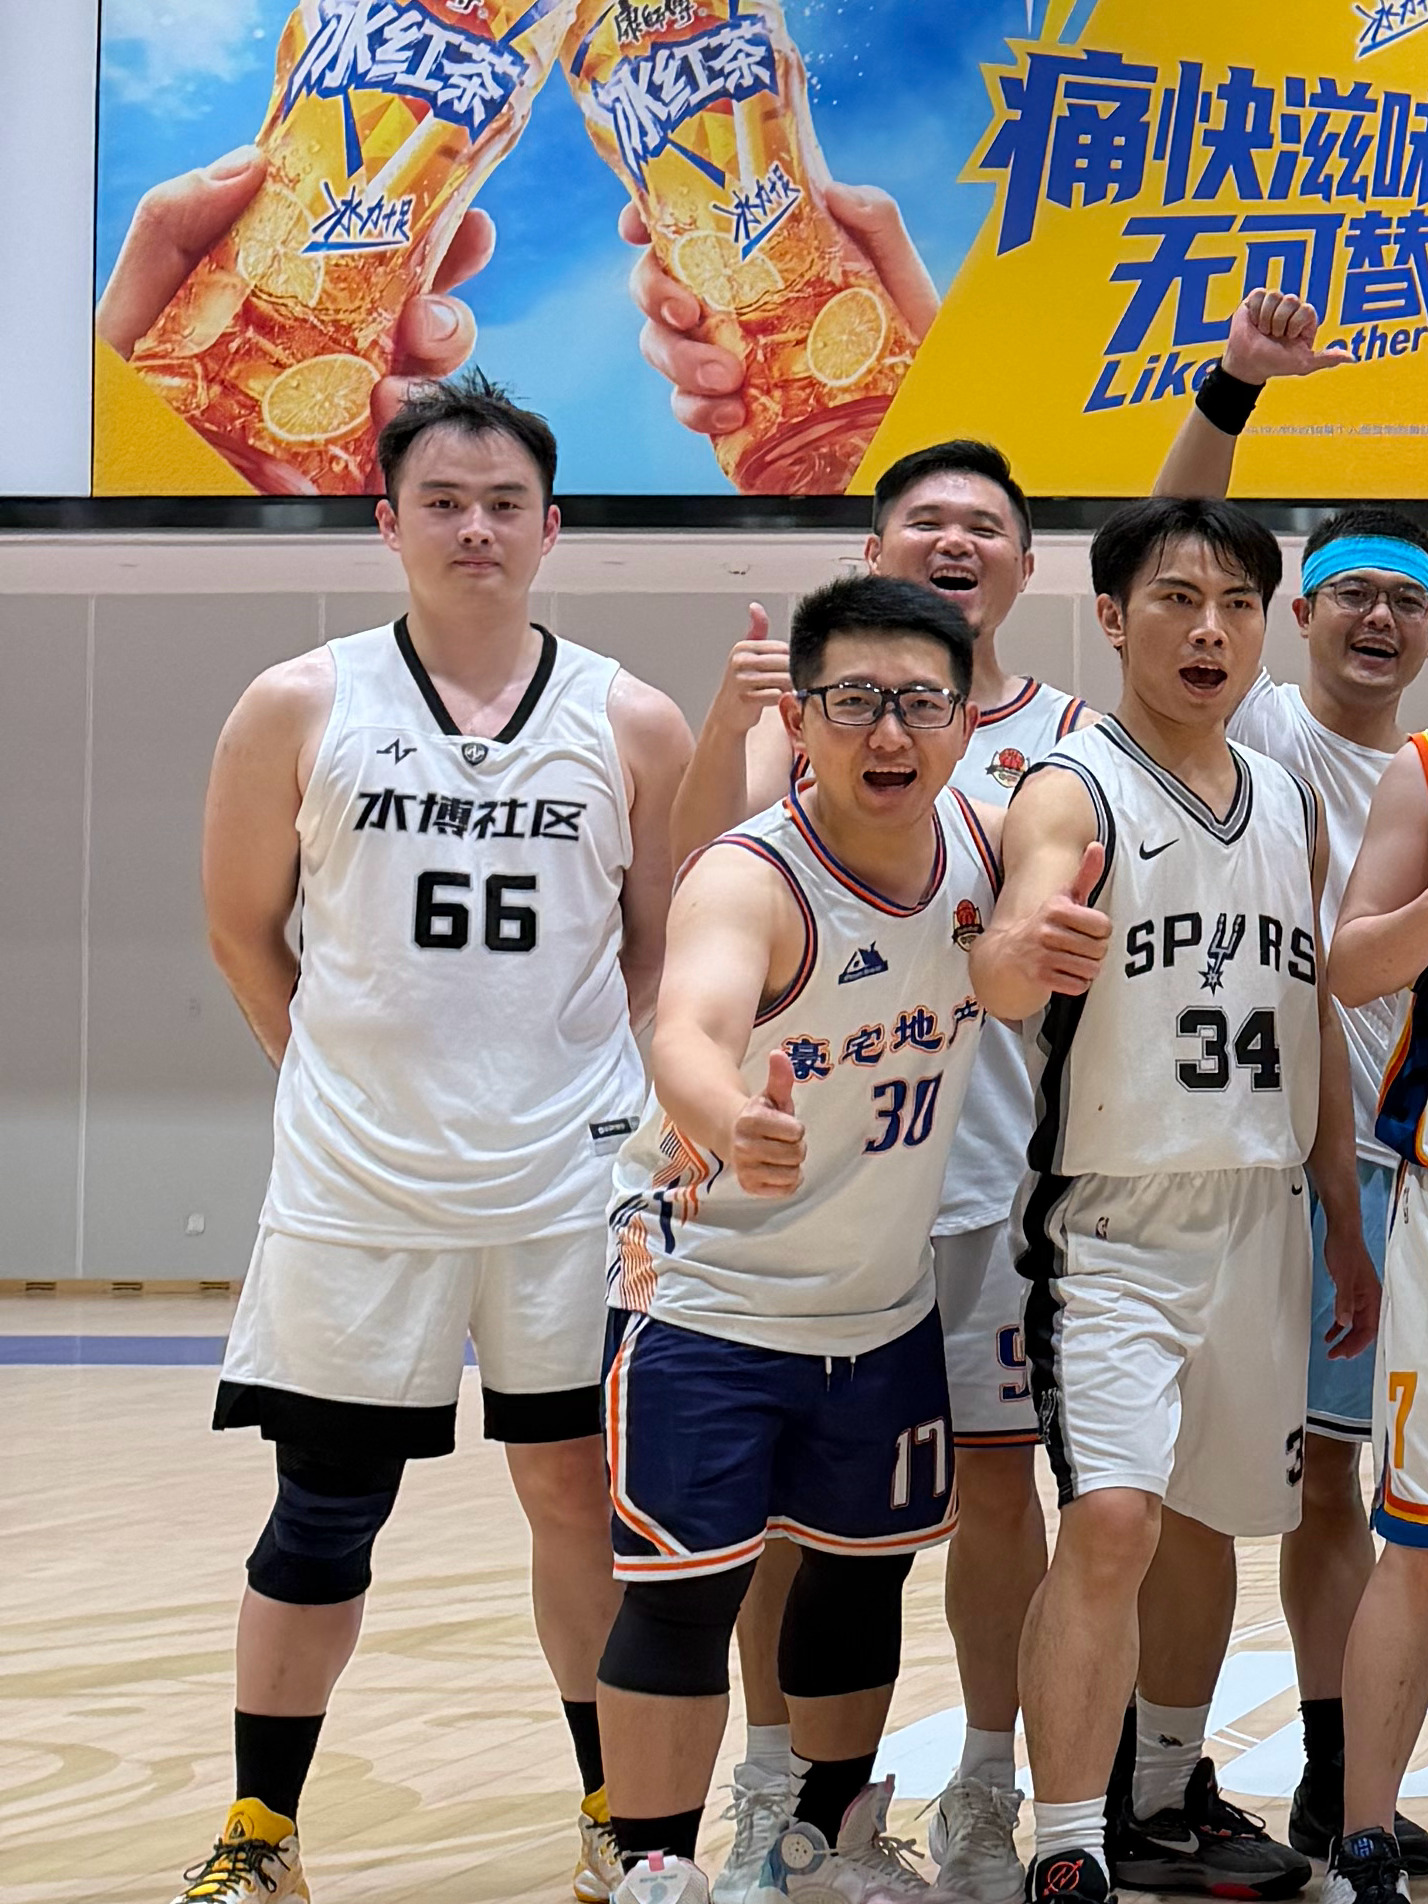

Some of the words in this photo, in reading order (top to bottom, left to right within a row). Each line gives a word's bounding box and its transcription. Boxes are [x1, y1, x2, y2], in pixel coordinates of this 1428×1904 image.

[598, 21, 771, 175] 冰红茶
[413, 871, 538, 953] 66
[1125, 912, 1316, 996] SPURS
[1175, 1005, 1282, 1092] 34
[863, 1069, 944, 1154] 30
[891, 1416, 948, 1509] 17
[1388, 1371, 1418, 1470] 7
